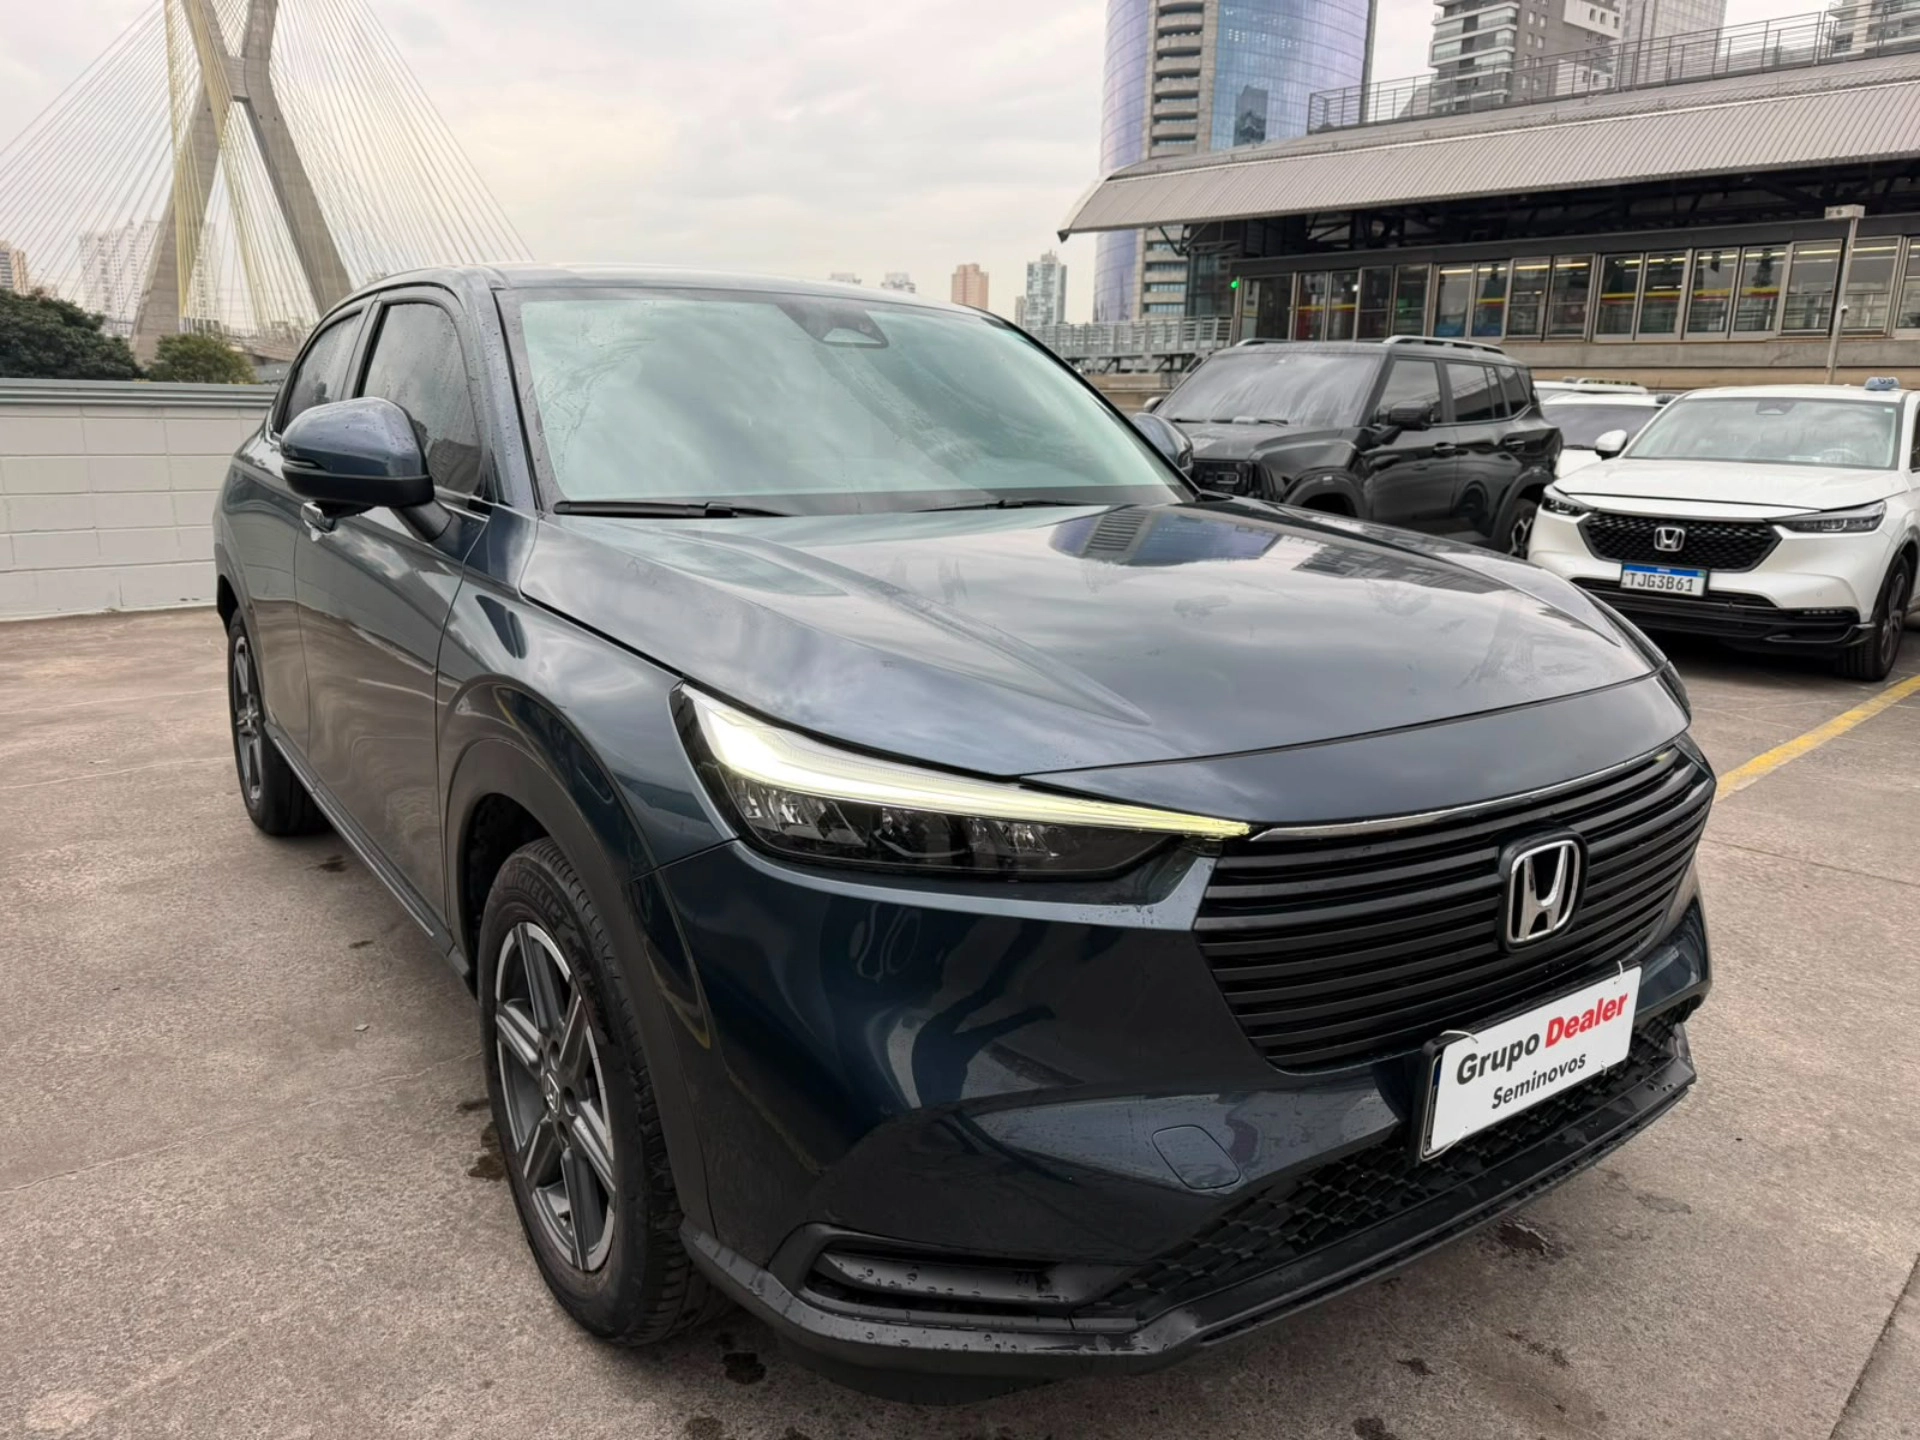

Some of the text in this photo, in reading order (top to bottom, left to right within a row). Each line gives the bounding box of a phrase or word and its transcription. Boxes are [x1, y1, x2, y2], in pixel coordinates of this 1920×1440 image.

[1630, 573, 1693, 592] TJG3B61
[1456, 993, 1628, 1085] Grupo Dealer
[1492, 1053, 1586, 1109] Seminovos
